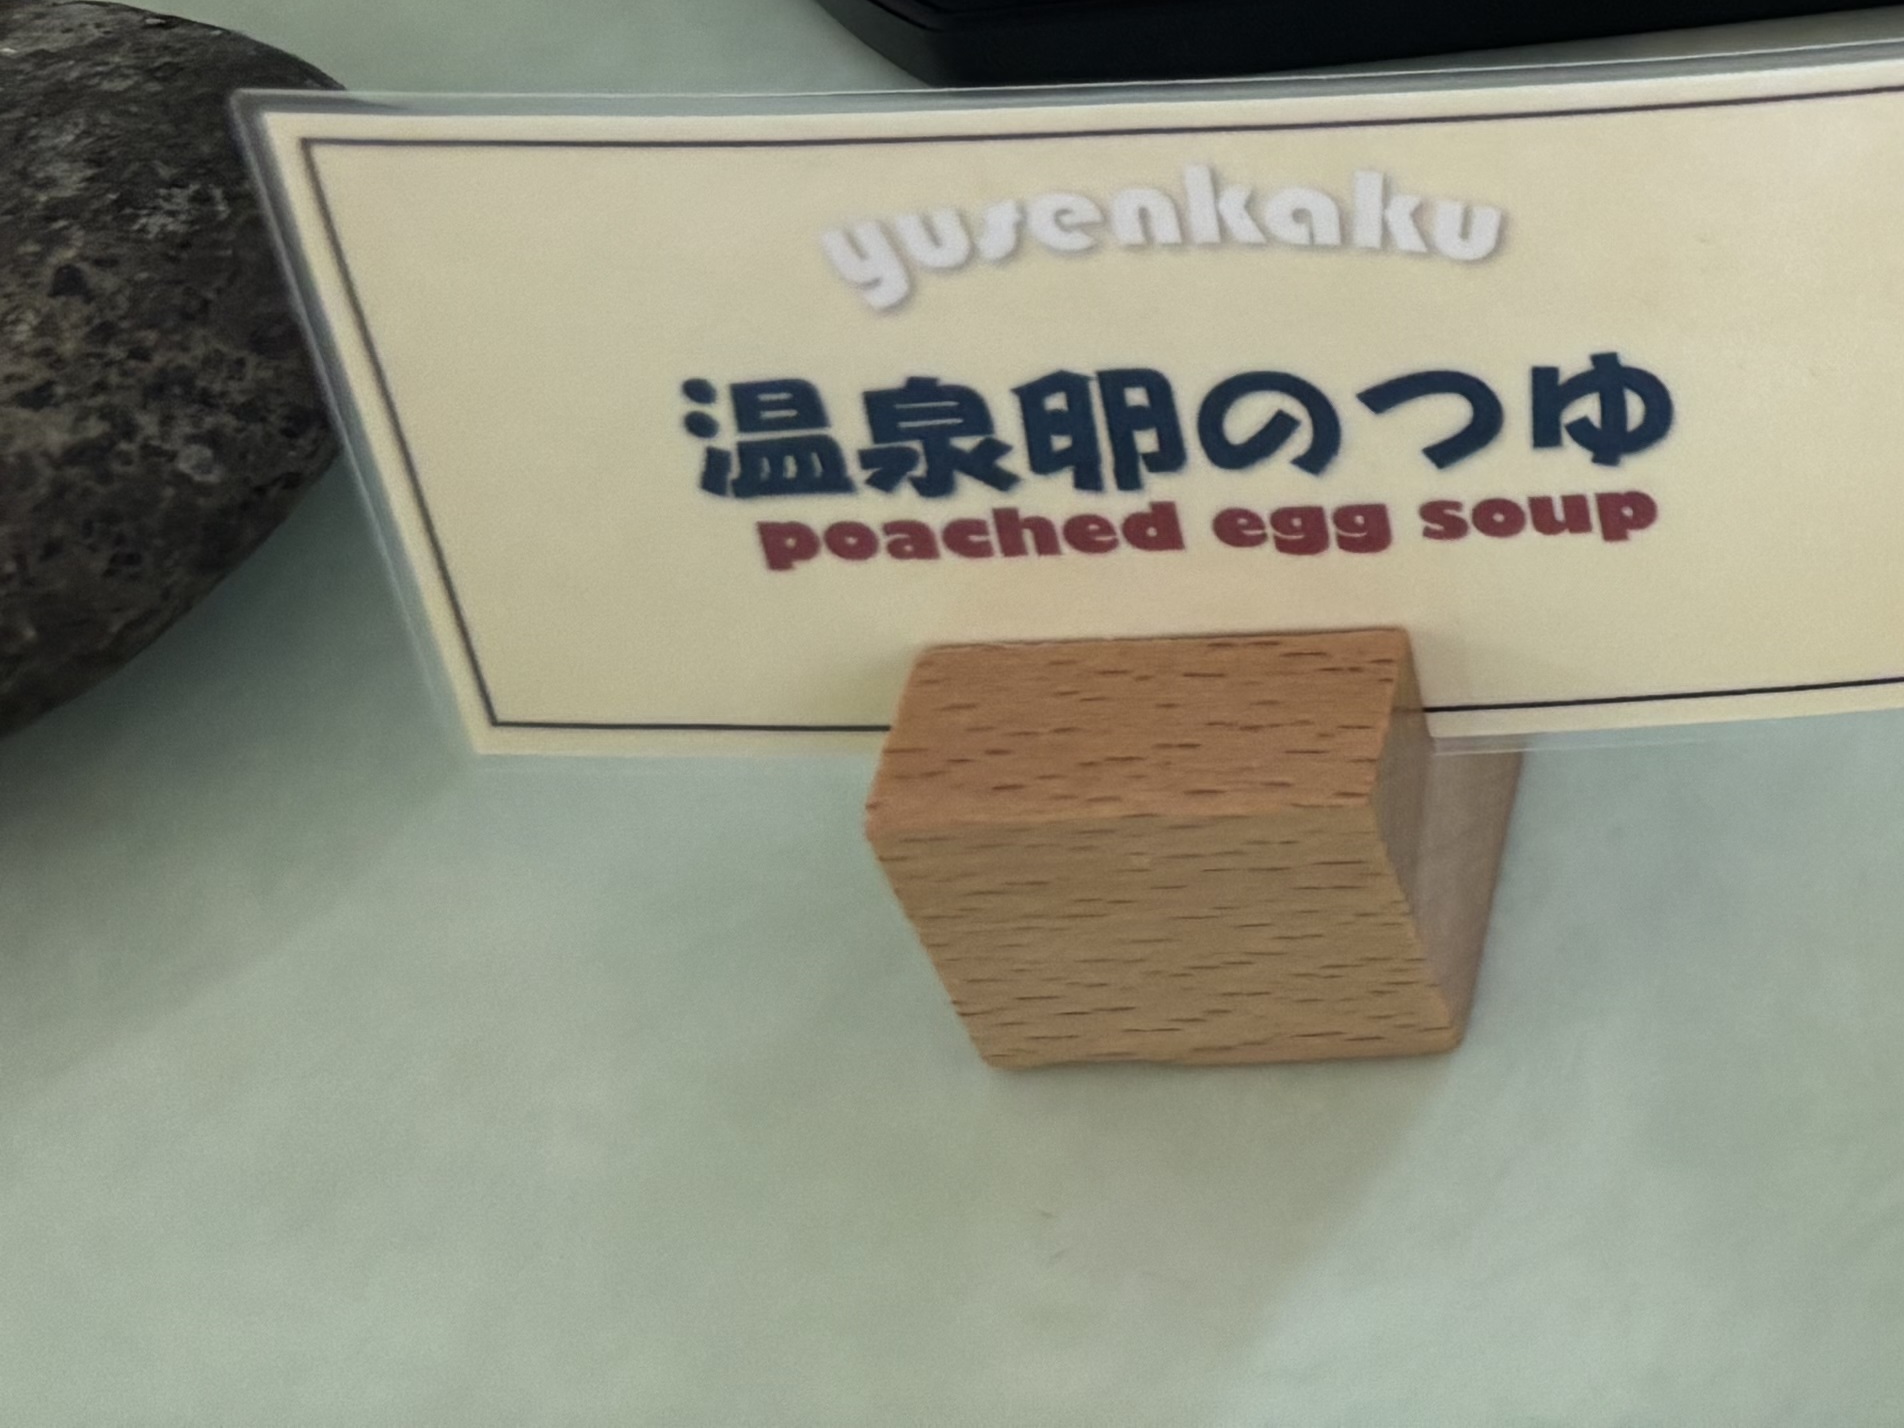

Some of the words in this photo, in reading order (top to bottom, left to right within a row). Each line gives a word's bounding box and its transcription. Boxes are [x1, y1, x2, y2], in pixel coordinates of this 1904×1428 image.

[820, 163, 1503, 312] yusenkaku
[680, 350, 1675, 499] 温泉卵のつゆ
[756, 501, 1186, 572] poached
[1211, 503, 1394, 556] egg
[1418, 490, 1659, 543] soup
